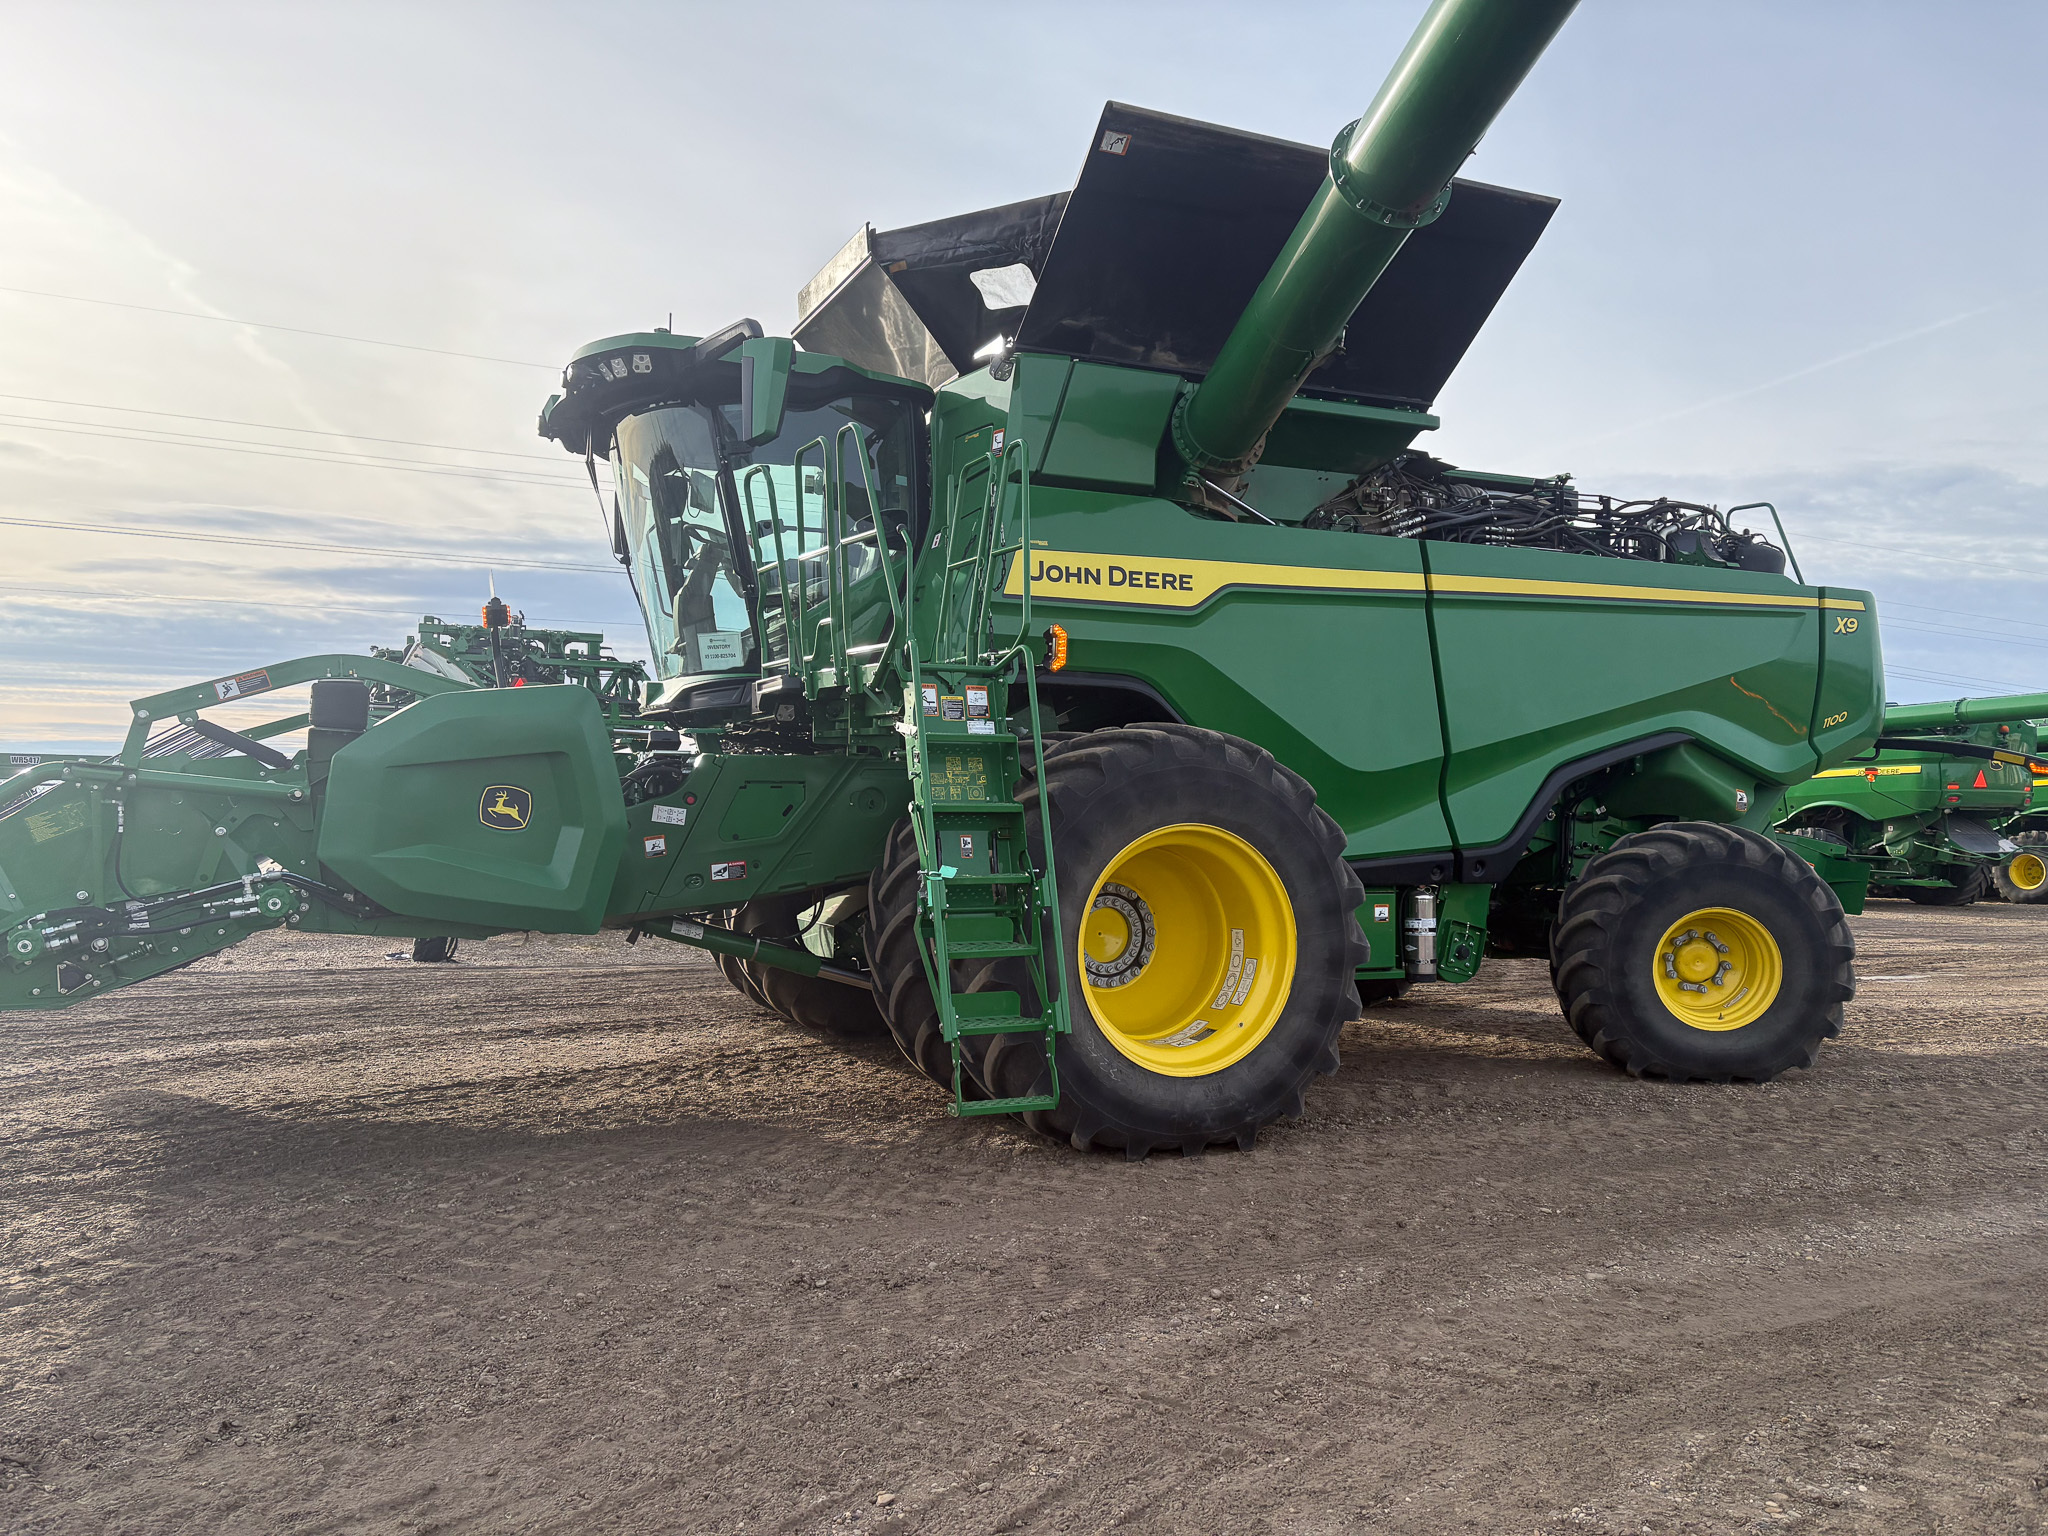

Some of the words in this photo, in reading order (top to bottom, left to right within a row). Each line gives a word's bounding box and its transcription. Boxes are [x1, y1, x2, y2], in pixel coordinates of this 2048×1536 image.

[1030, 560, 1101, 586] JOHN
[1108, 565, 1194, 591] DEERE
[1833, 616, 1858, 635] X9
[1822, 711, 1848, 729] 1100
[10, 755, 41, 764] WR5417
